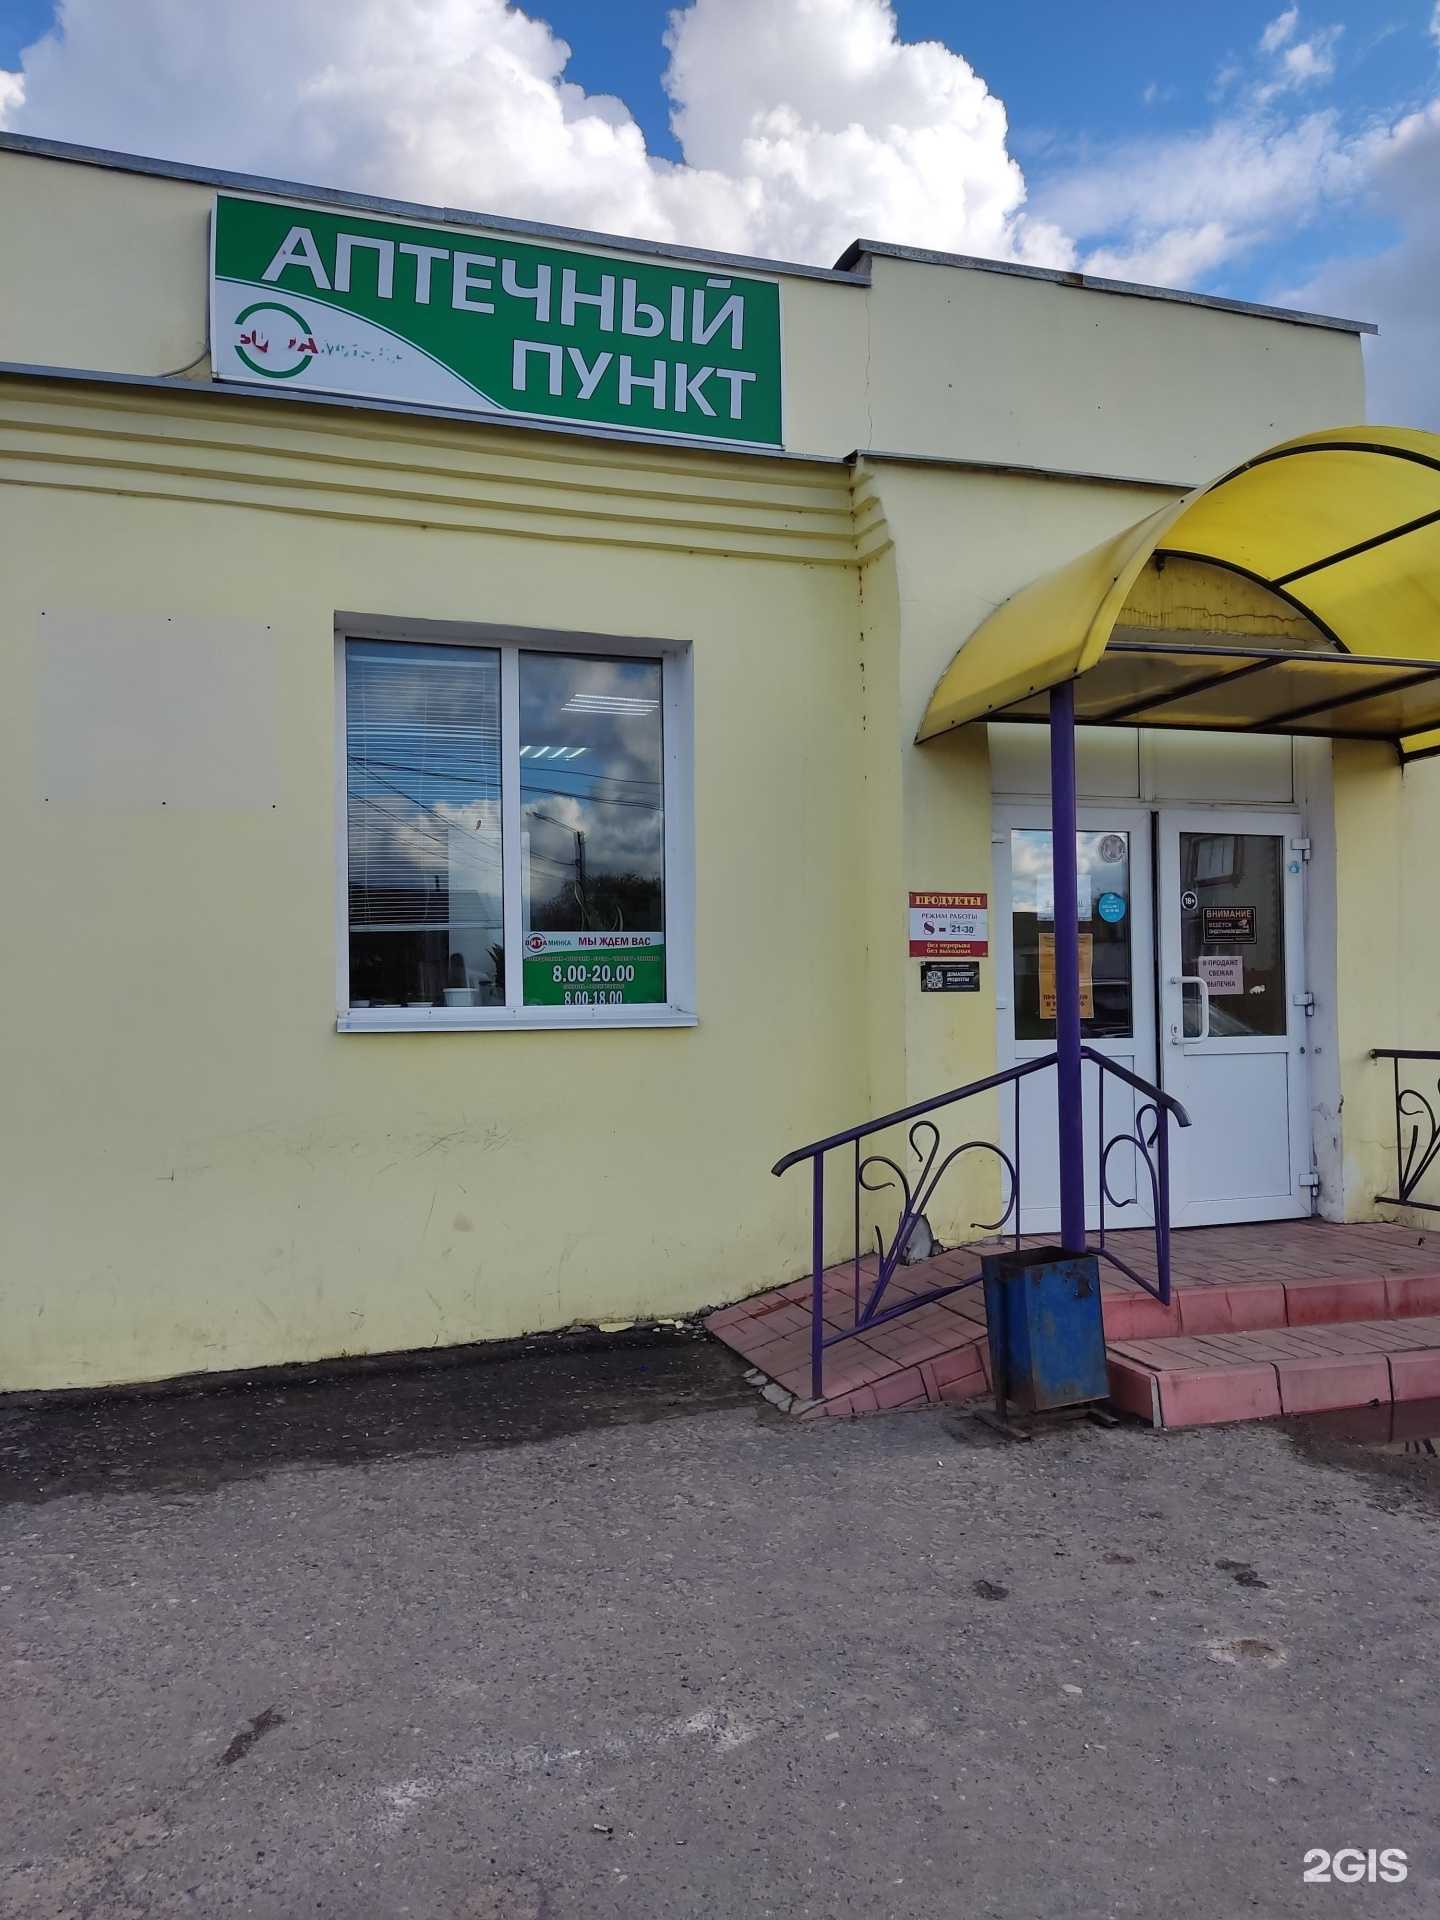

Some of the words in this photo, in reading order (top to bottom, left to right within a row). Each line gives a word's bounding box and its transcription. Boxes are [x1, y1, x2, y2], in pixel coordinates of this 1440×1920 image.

[262, 226, 744, 350] АПТЕЧНЫЙ
[512, 339, 757, 420] ПУНКТ
[915, 896, 982, 907] ПРОДУКТЫ
[1185, 897, 1195, 905] 18+
[1206, 910, 1252, 918] ВНИМАНИЕ
[951, 925, 974, 934] 21-30
[578, 937, 597, 946] МЫ
[599, 937, 628, 947] ЖДЕМ
[632, 937, 651, 946] ВАС
[552, 965, 635, 982] 8.00-20.00
[564, 991, 623, 1005] 8.00-18.00
